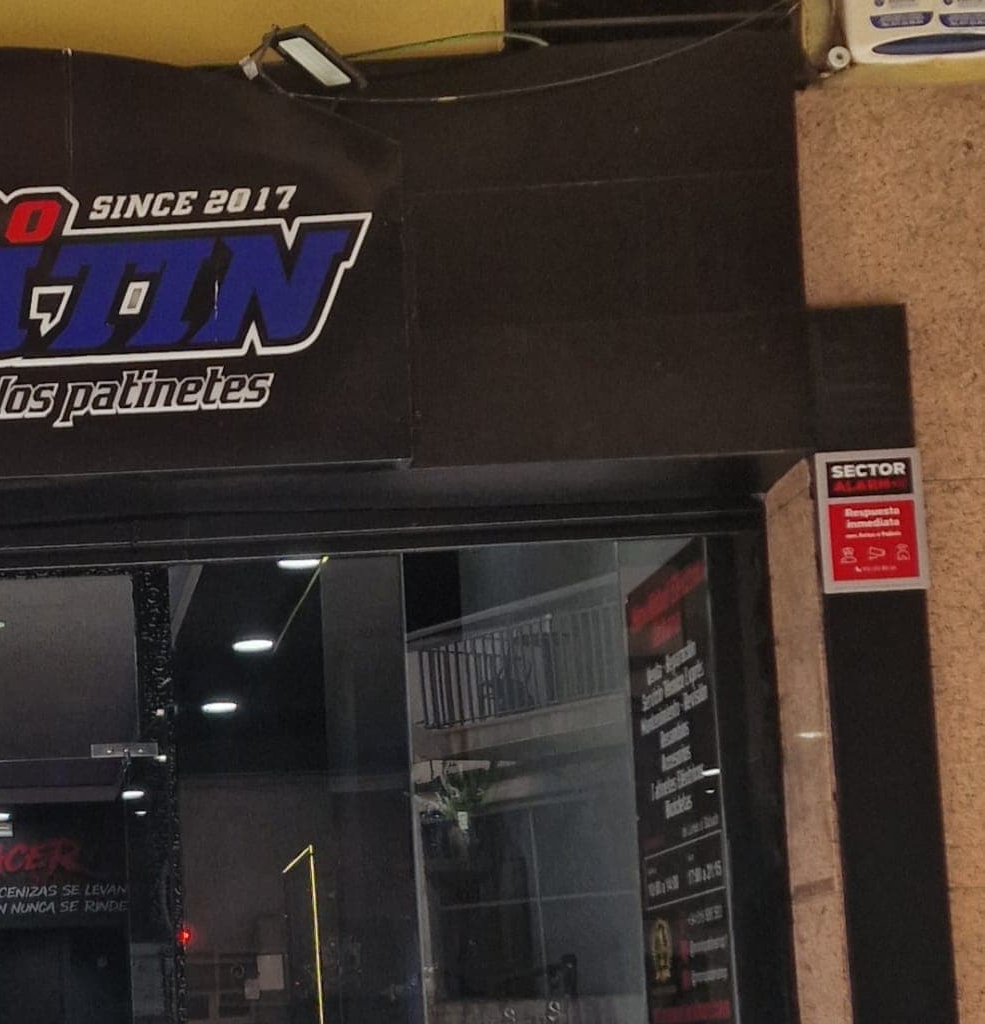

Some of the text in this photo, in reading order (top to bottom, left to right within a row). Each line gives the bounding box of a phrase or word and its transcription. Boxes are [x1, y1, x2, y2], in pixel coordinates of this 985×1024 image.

[89, 185, 298, 221] SINCE 2017
[53, 368, 275, 430] patinetes
[831, 461, 906, 479] SECTOR
[63, 884, 80, 897] SE
[11, 900, 57, 915] NUNCA
[60, 900, 79, 913] SE
